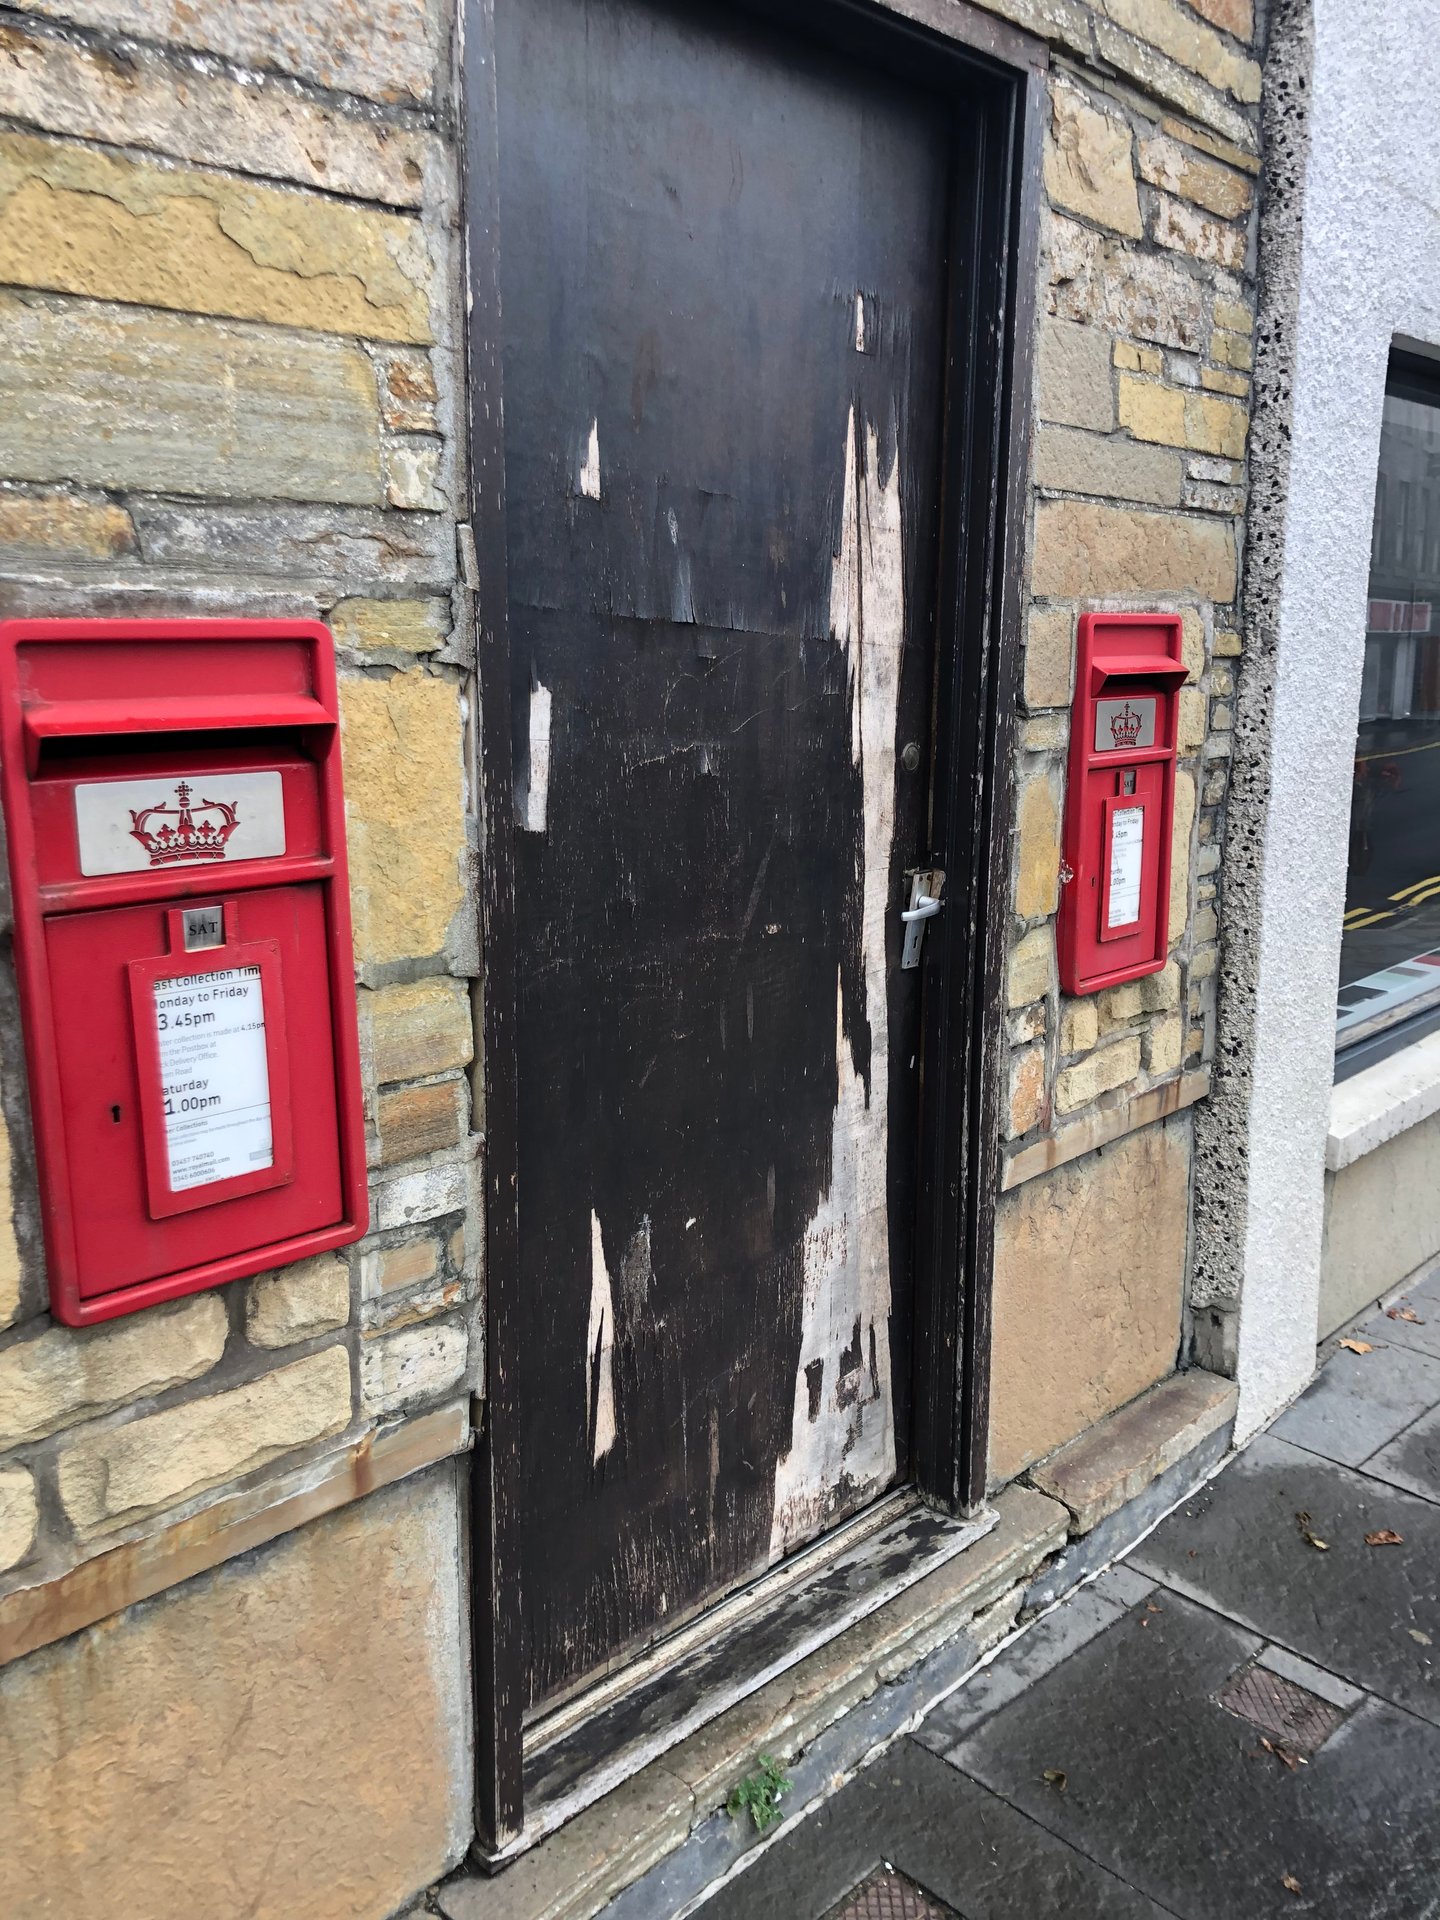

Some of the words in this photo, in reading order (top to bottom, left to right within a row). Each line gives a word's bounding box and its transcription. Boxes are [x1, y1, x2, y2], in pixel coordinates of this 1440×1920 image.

[188, 921, 218, 936] SAT
[175, 970, 234, 988] Collection
[197, 993, 210, 1003] to
[212, 986, 249, 1001] Friday
[158, 1012, 216, 1031] 3.45pm
[163, 1094, 222, 1116] 1.00pm
